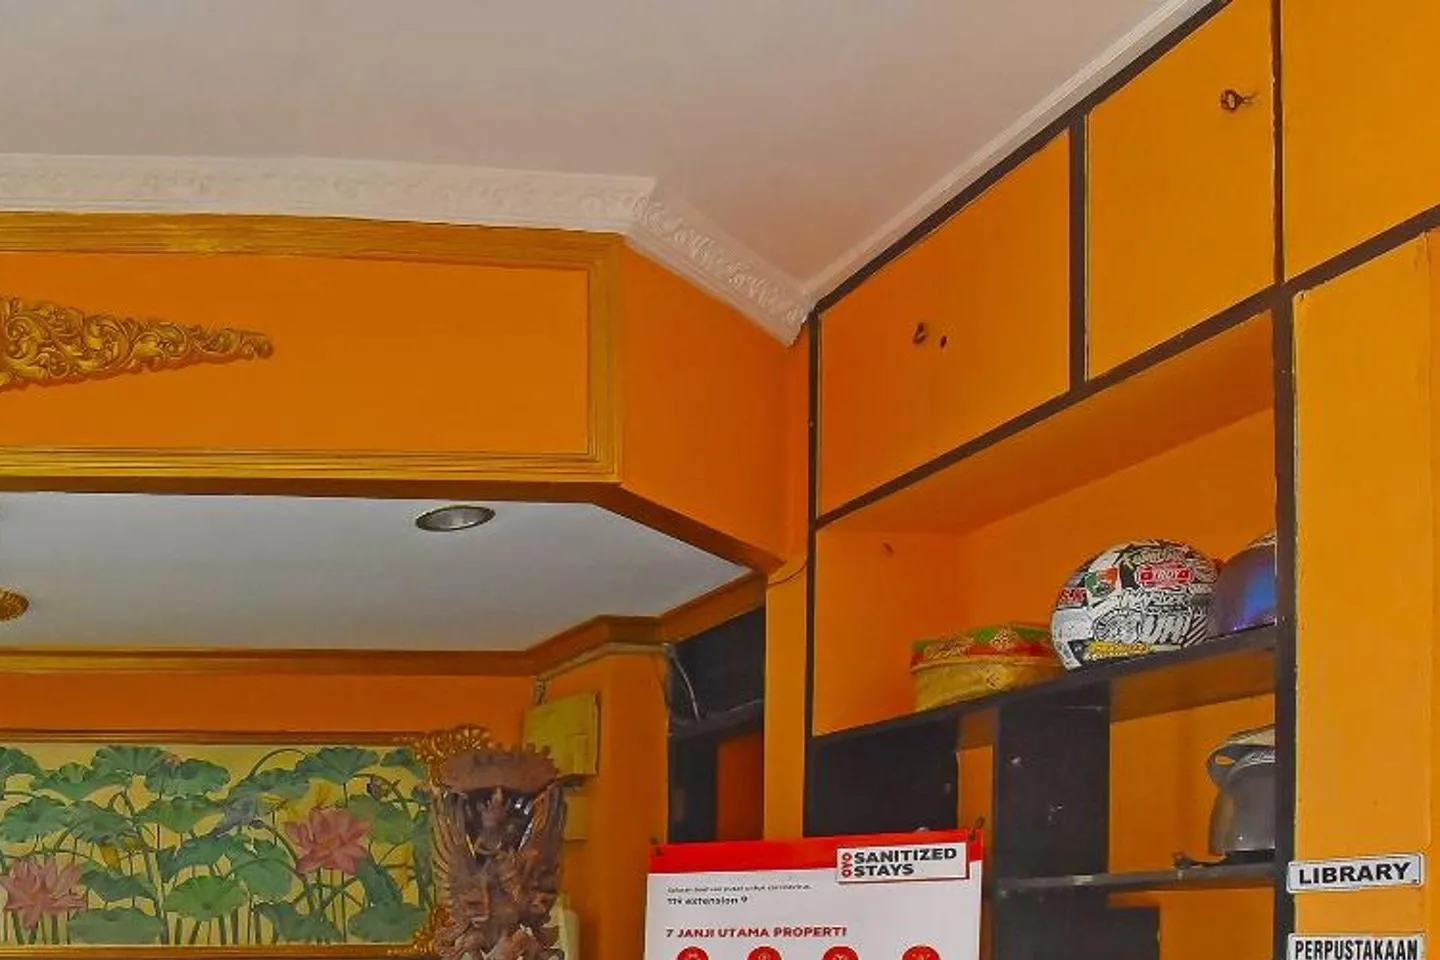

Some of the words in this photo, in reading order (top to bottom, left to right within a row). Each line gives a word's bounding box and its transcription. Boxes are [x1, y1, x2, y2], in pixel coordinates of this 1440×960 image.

[854, 848, 957, 864] SANITIZED
[854, 863, 914, 877] STAYS
[1299, 861, 1411, 884] LIBRARY
[666, 928, 674, 938] 7
[677, 928, 715, 938] JANJI
[718, 928, 770, 938] UTAMA
[773, 926, 847, 938] PROPERTI
[1295, 939, 1418, 960] PERPUSTAKAAN
